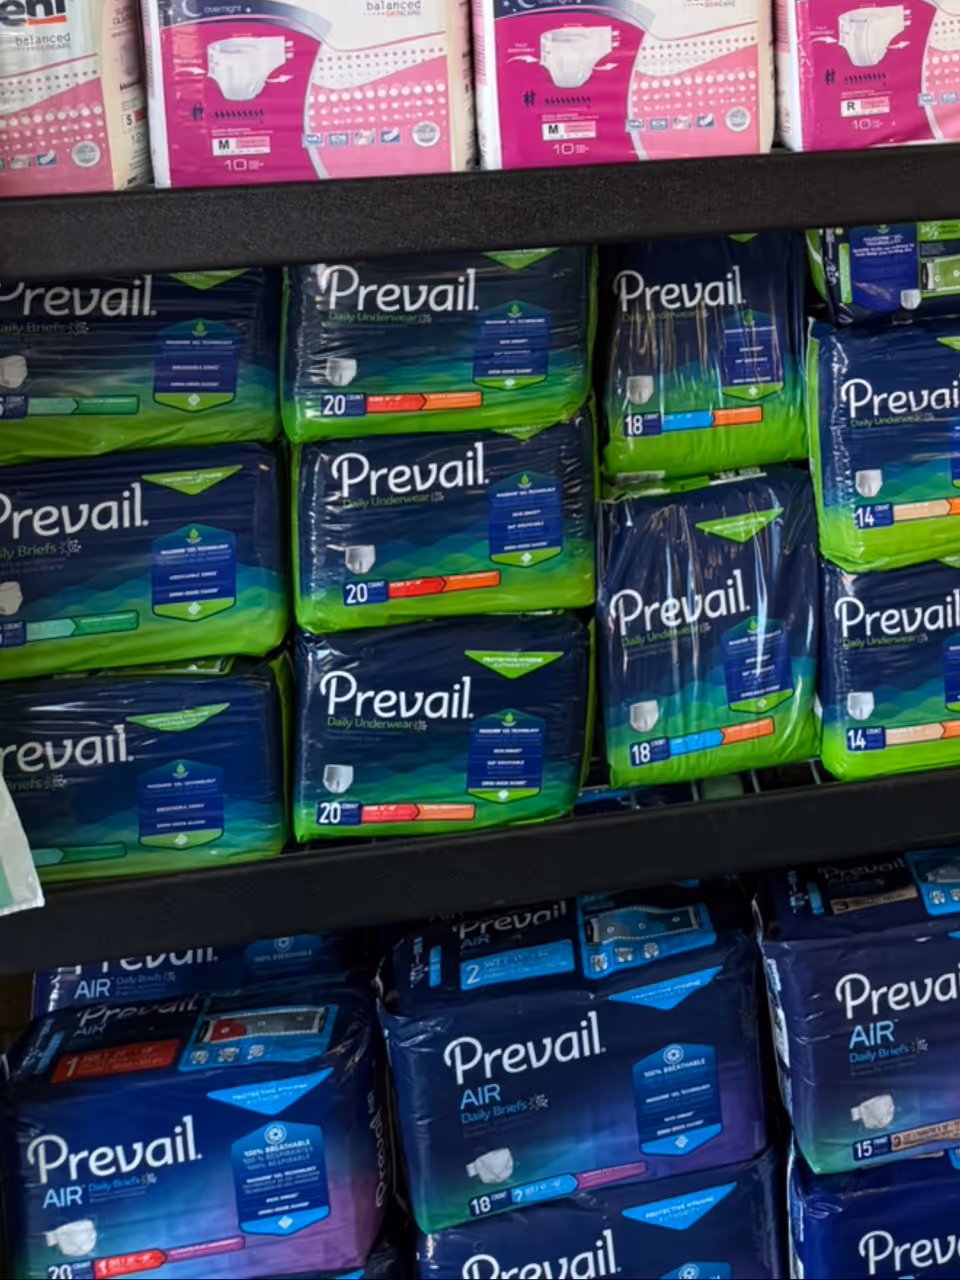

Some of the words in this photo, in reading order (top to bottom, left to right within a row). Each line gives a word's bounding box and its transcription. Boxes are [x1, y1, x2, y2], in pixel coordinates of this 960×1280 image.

[203, 4, 243, 15] overnight
[366, 0, 422, 11] balanced
[15, 32, 72, 48] balanced
[847, 101, 856, 111] R
[547, 123, 560, 135] M
[217, 138, 231, 150] M
[325, 264, 477, 313] Prevail
[613, 265, 743, 312] Prevail
[328, 311, 355, 324] Daily
[357, 312, 420, 324] Underwear
[322, 394, 347, 416] 20
[625, 414, 643, 435] 18
[331, 441, 486, 498] Prevail
[857, 507, 875, 527] 14
[18, 543, 57, 557] Briefs
[345, 582, 369, 605] 20
[609, 568, 747, 636] Prevail
[320, 670, 472, 720] Prevail
[327, 716, 353, 730] Daily
[354, 717, 413, 731] Underwear
[0, 724, 127, 771] revail
[847, 729, 867, 750] 14
[631, 743, 650, 765] 18
[319, 802, 341, 824] 20
[466, 964, 480, 985] 2
[74, 978, 111, 1000] AIR
[849, 1021, 896, 1049] AIR
[443, 1010, 602, 1085] Prevail
[848, 1049, 877, 1064] Daily
[877, 1042, 910, 1059] Briefs
[460, 1084, 502, 1110] AIR
[460, 1106, 491, 1125] Daily
[492, 1099, 528, 1118] Briefs
[27, 1115, 195, 1185] Prevail
[855, 1139, 873, 1158] 15
[42, 1186, 83, 1209] AIR
[471, 1195, 492, 1215] 18
